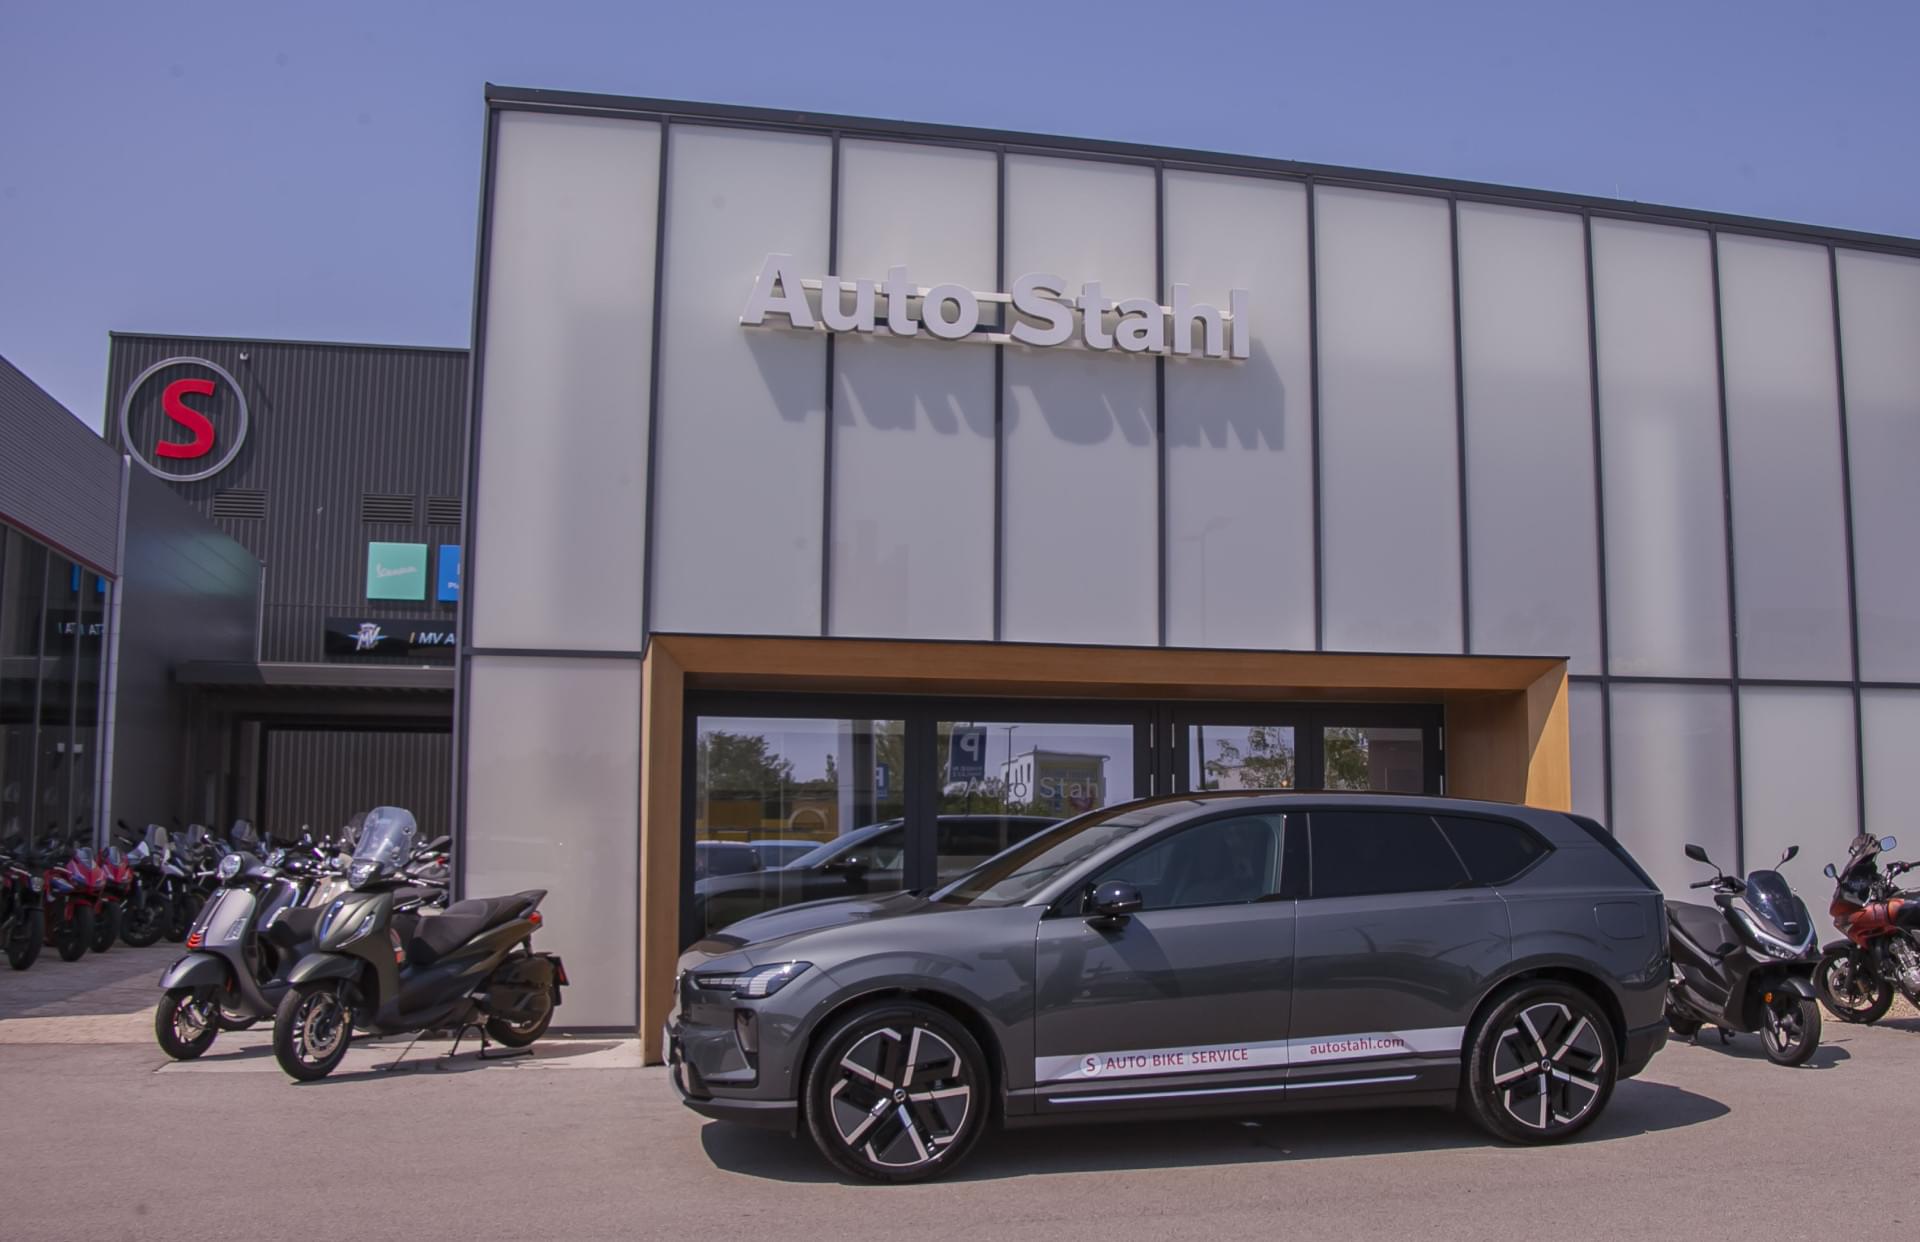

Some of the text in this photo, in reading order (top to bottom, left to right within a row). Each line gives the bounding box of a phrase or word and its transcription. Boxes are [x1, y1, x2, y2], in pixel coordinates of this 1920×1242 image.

[739, 252, 1251, 360] Auto Stahl
[154, 378, 216, 460] S
[418, 631, 444, 645] MV
[1310, 1037, 1405, 1055] autostahl.com
[1085, 1048, 1249, 1072] S AUTO BIKE SERVICE
